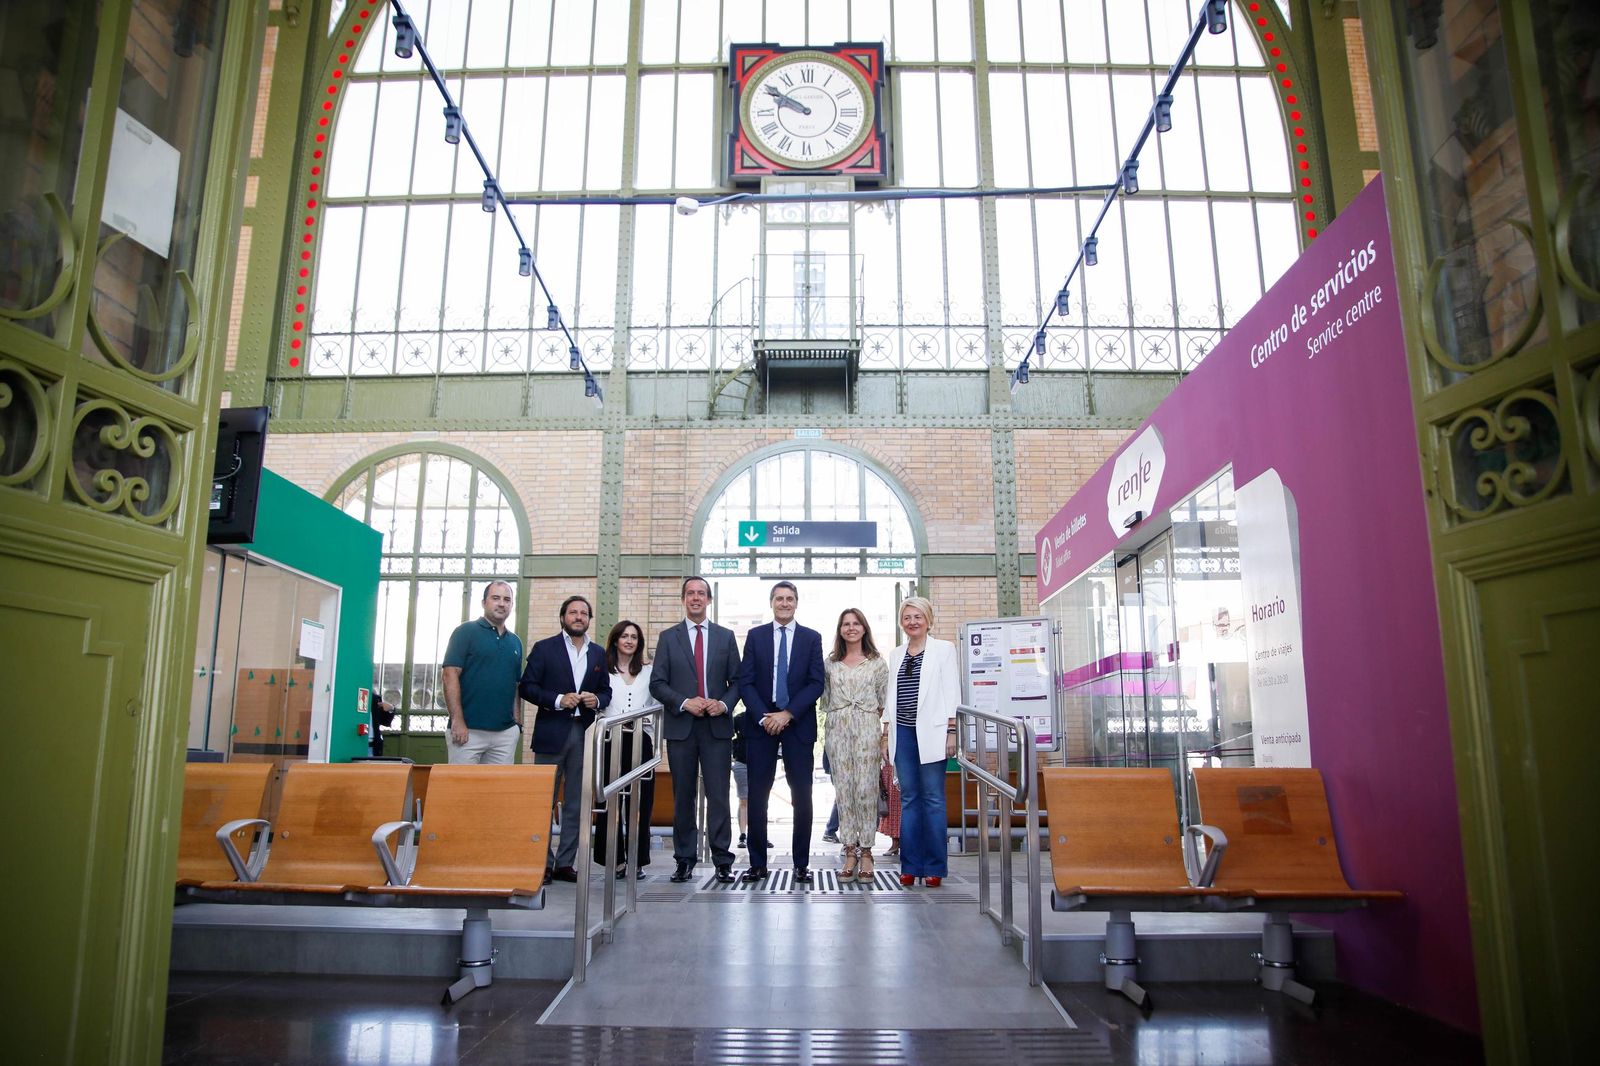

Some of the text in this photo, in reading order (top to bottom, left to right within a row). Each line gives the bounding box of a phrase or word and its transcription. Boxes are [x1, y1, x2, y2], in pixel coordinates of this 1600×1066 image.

[800, 69, 814, 83] XII
[1250, 240, 1376, 369] Centro de servicios
[1307, 285, 1382, 359] Service centre
[1118, 452, 1151, 506] renfe
[773, 525, 800, 535] Salida
[1252, 595, 1285, 623] Horario
[1255, 643, 1293, 661] Centro de viajes
[1261, 732, 1301, 746] Venta anticipada
